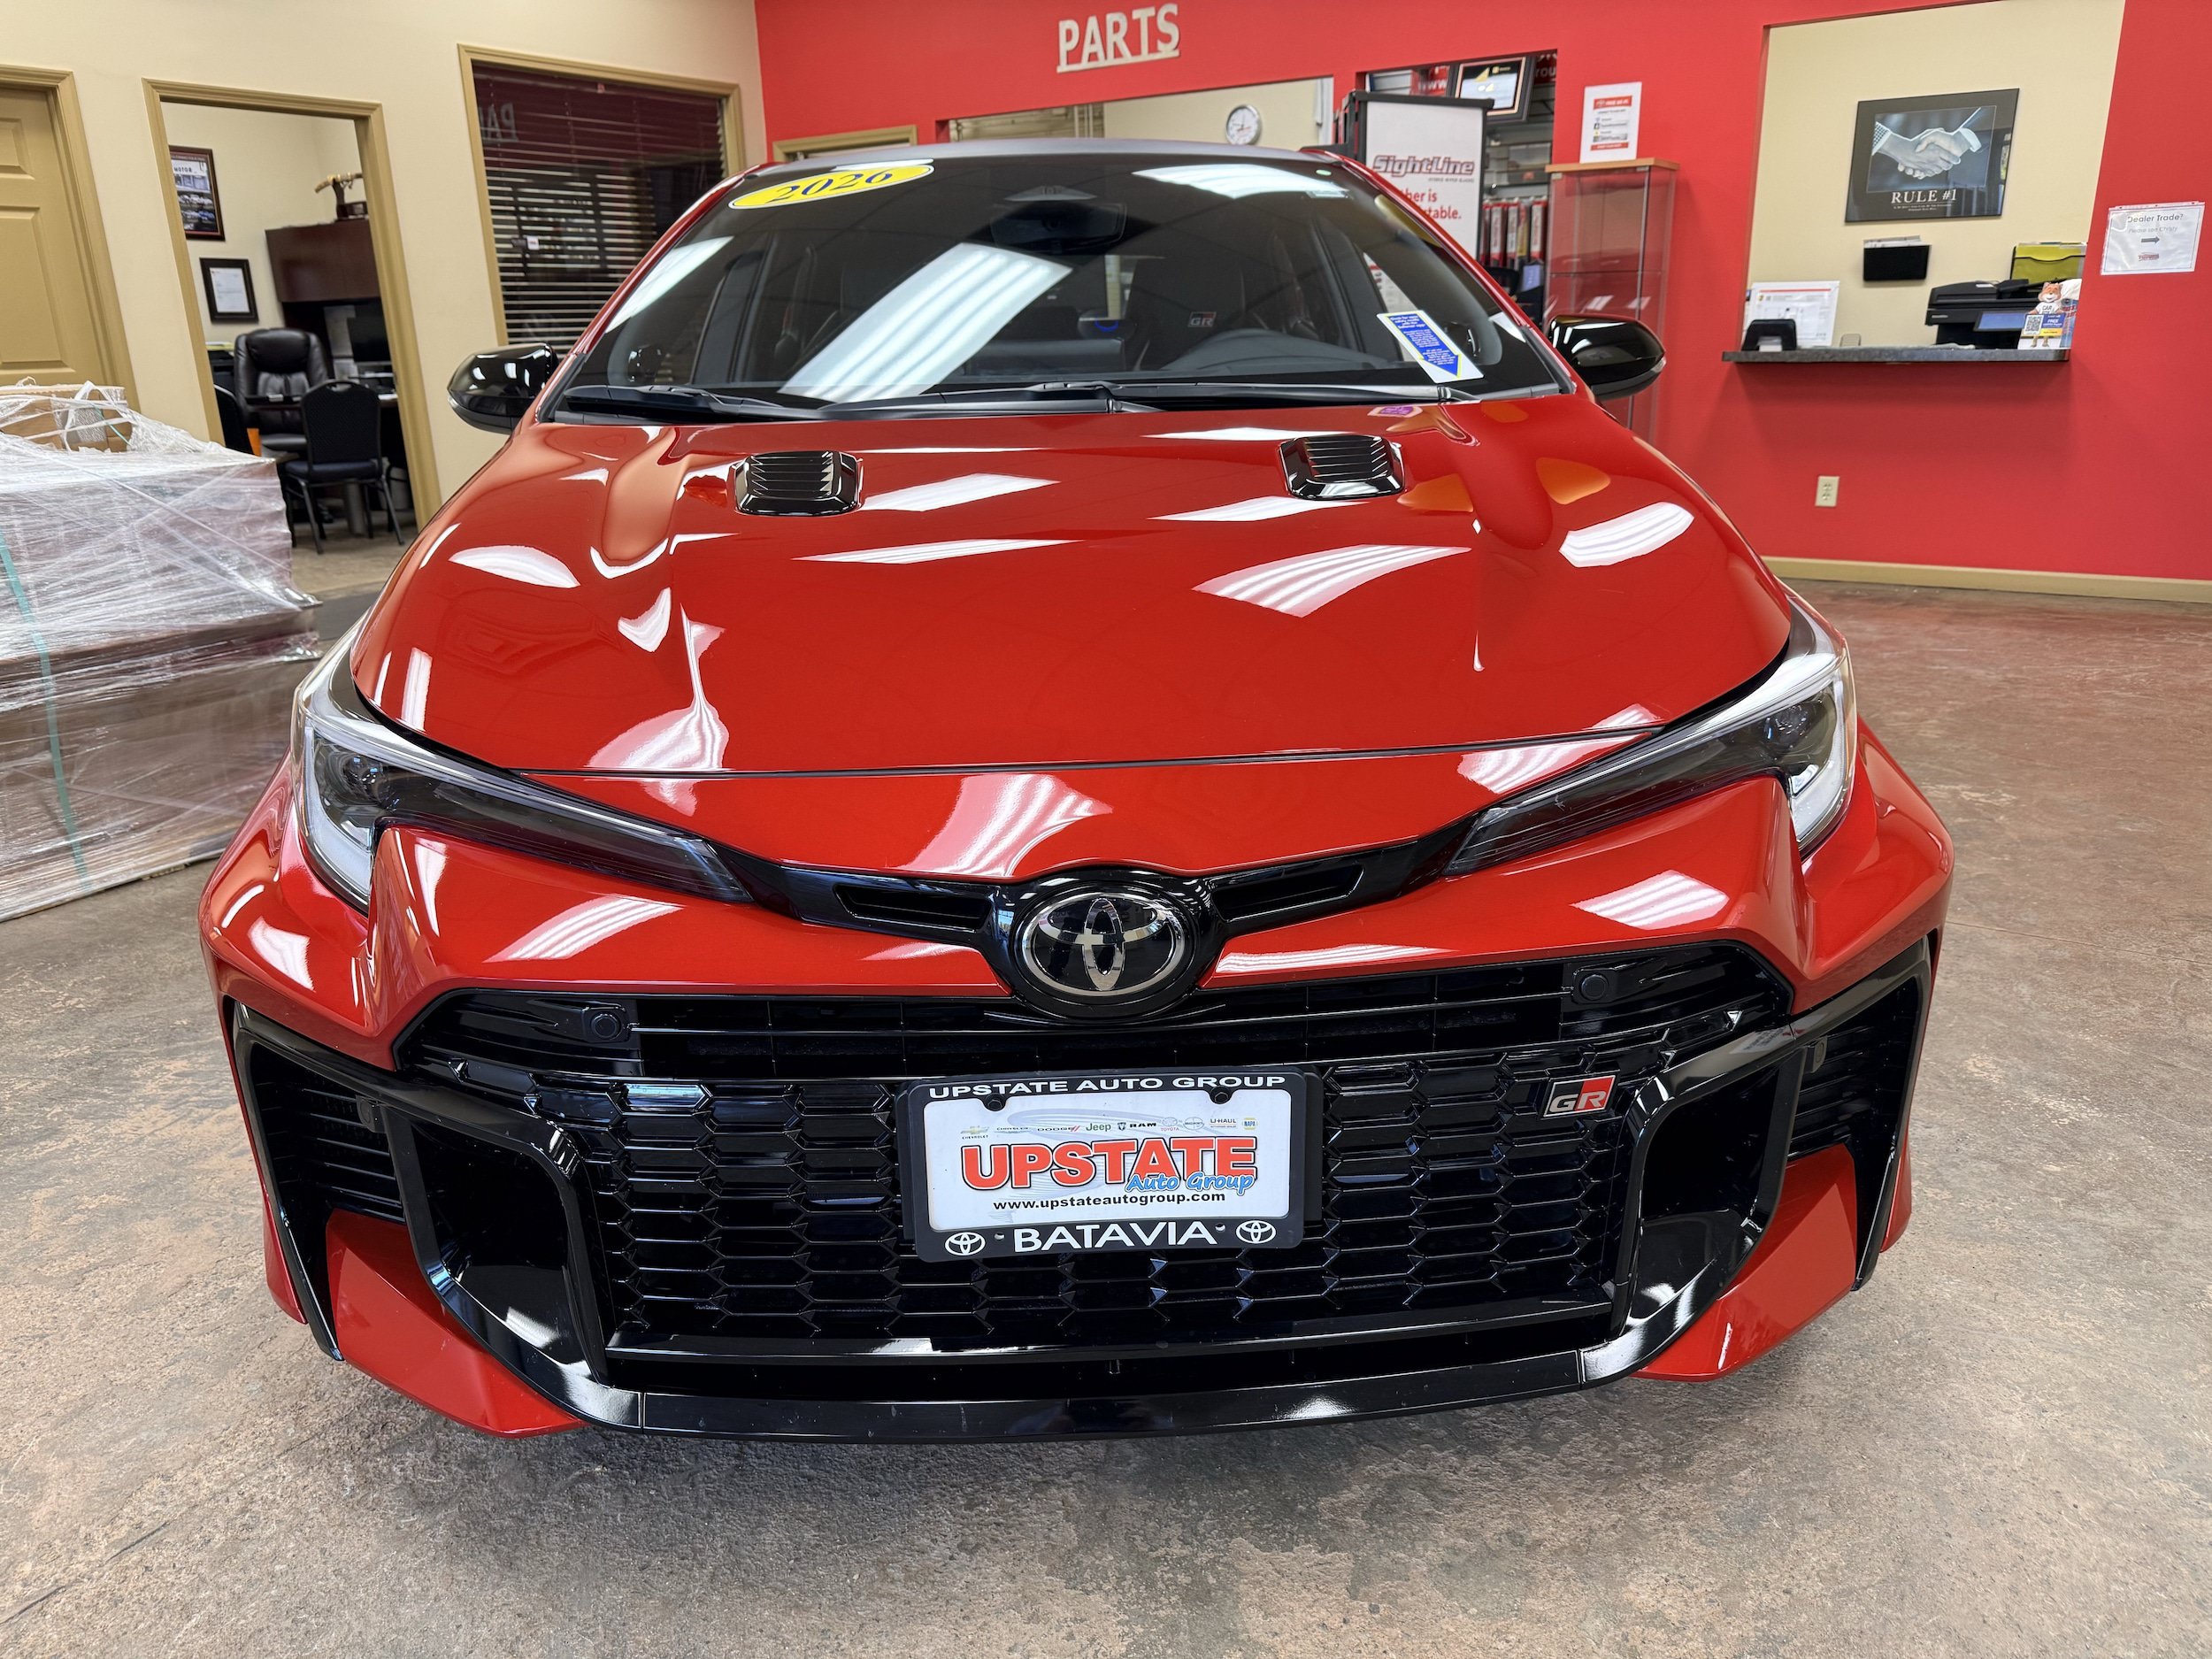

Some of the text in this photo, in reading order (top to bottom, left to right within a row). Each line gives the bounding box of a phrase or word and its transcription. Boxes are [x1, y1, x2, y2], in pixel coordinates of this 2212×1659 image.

[1057, 3, 1180, 71] PARTS
[1373, 155, 1475, 177] SightLine
[764, 168, 894, 204] 2026
[1428, 188, 1438, 203] is
[1891, 188, 1957, 204] RULE #1
[1190, 318, 1213, 326] GR
[929, 1076, 1286, 1098] UPSTATE AUTO GROUP
[1549, 1090, 1607, 1112] GR
[1086, 1123, 1111, 1133] Jeep
[961, 1136, 1257, 1190] UPSTATE
[1125, 1171, 1255, 1196] Auto Group
[994, 1193, 1225, 1210] www.upstateautogroup.com
[1014, 1221, 1217, 1252] BATAVIA
